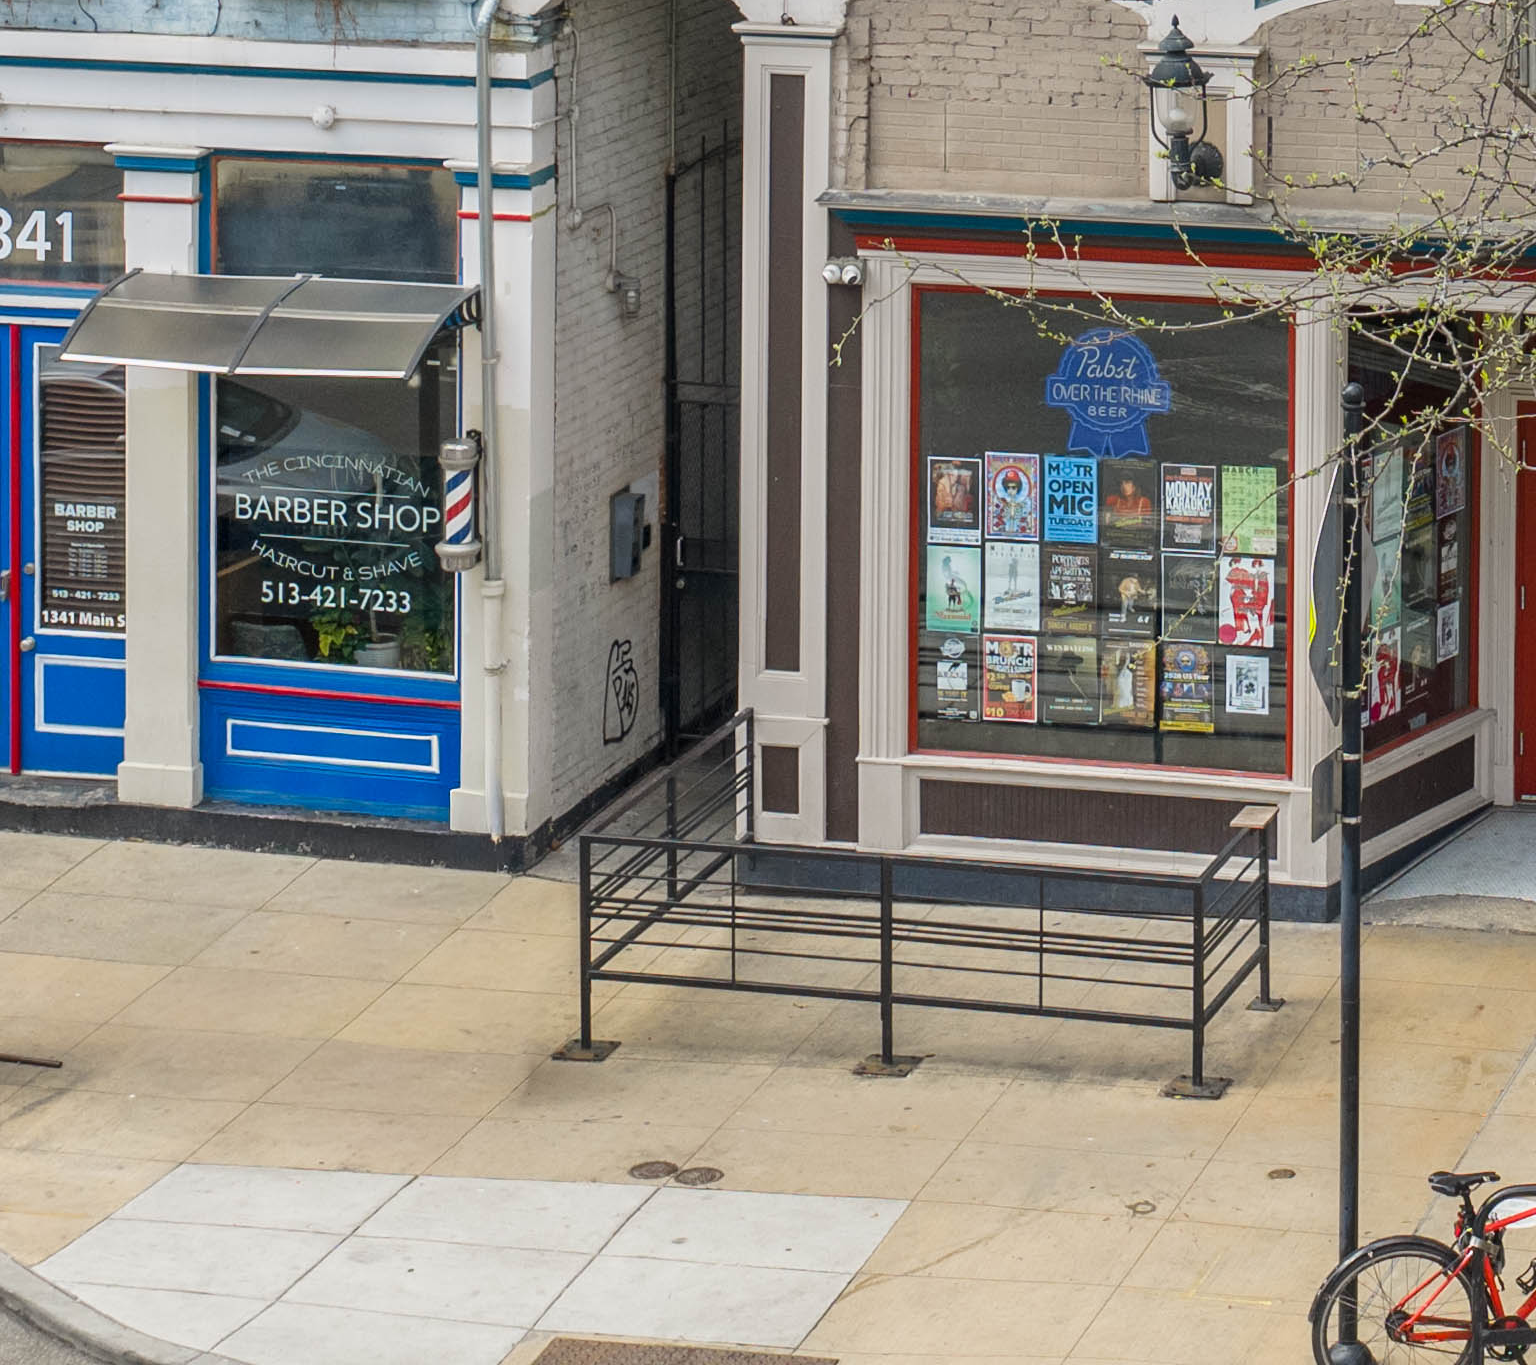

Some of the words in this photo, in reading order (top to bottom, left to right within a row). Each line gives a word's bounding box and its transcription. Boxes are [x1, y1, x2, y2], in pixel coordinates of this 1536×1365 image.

[1076, 345, 1140, 379] Pabst
[1052, 382, 1090, 402] OVER
[1092, 384, 1119, 403] THE
[1120, 385, 1162, 406] RHINE
[1087, 405, 1128, 418] BEER
[242, 461, 281, 485] THE
[283, 453, 431, 499] CINCINNATIAN
[1048, 479, 1094, 494] OPEN
[1165, 481, 1213, 498] MONDAY
[54, 502, 117, 519] BARBER
[235, 493, 348, 527] BARBER
[356, 501, 441, 533] SHOP
[1048, 494, 1094, 516] MIC
[66, 520, 105, 532] SHOP
[1048, 517, 1094, 527] TUESDAYS
[251, 539, 340, 580] HAIRCUT
[343, 566, 354, 581] &
[358, 551, 423, 581] SHAVE
[260, 581, 412, 614] 513-421-7233
[42, 610, 76, 624] 1341
[79, 612, 115, 626] Main
[117, 614, 126, 628] S
[985, 655, 1034, 667] BRUNCH!
[986, 708, 1004, 717] $10
